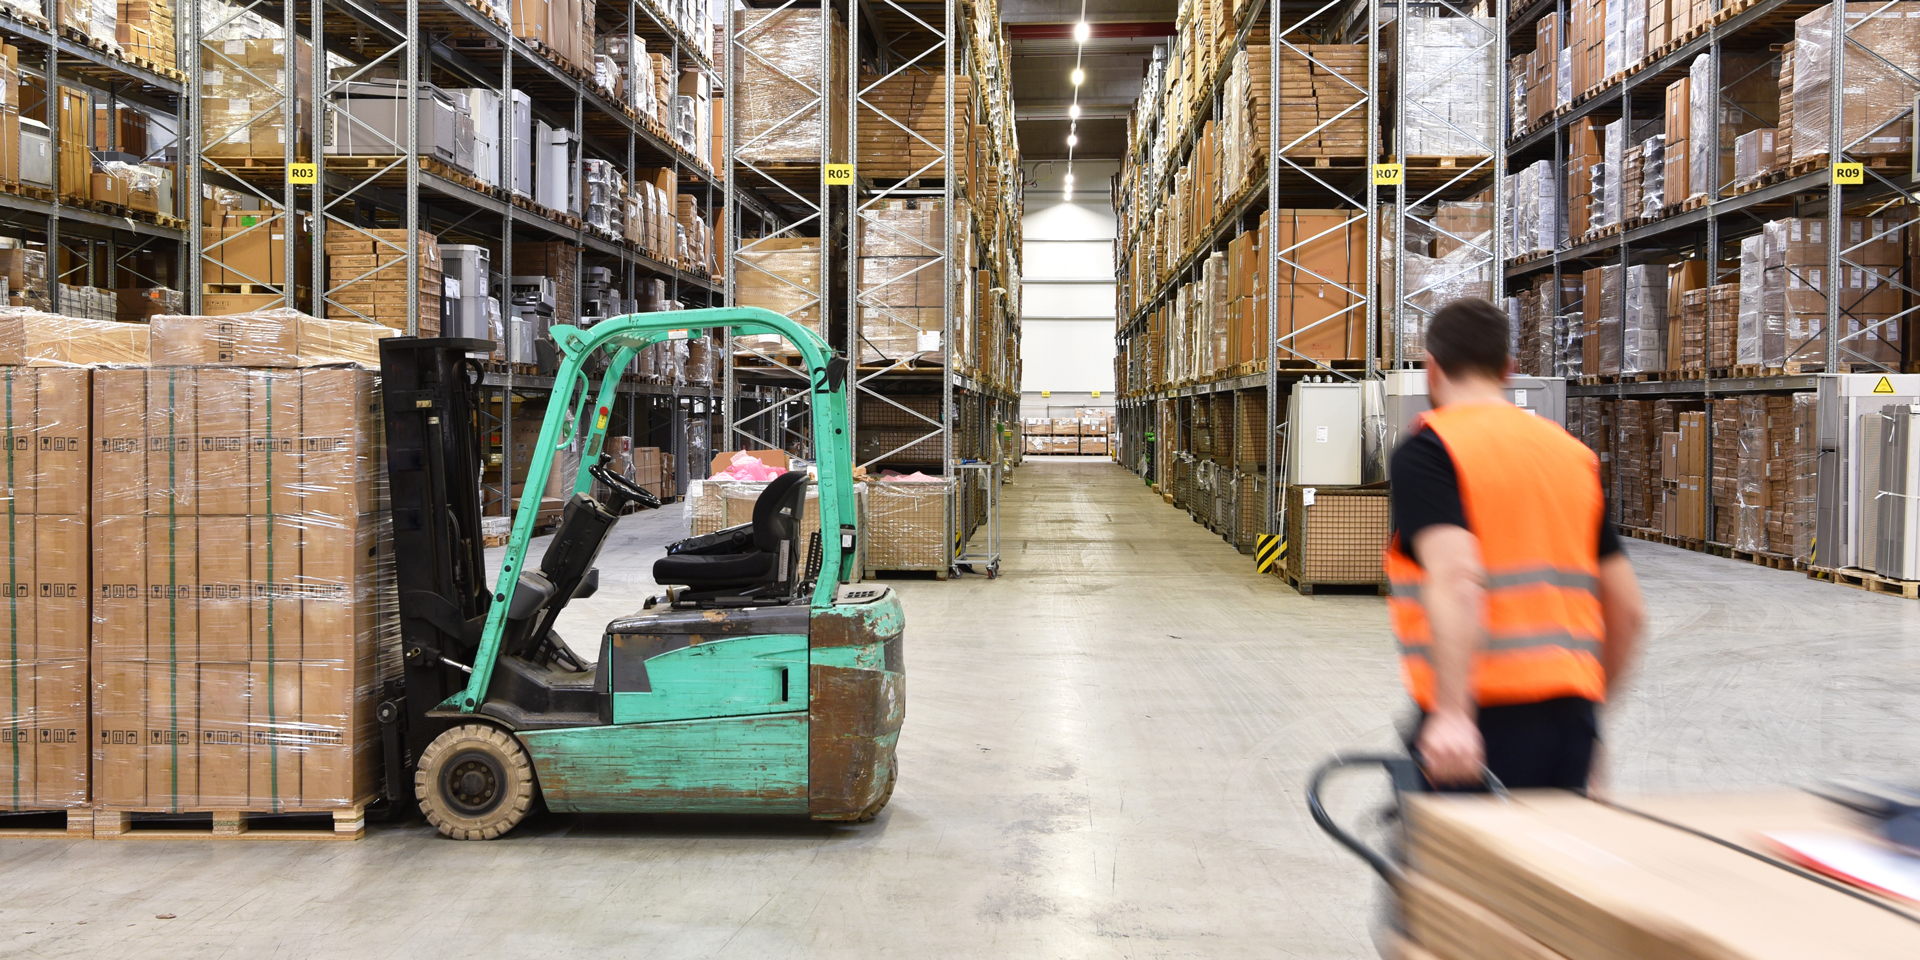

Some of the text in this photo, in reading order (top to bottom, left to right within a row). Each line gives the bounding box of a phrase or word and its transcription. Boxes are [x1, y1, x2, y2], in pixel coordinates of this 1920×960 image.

[292, 169, 314, 178] R03
[828, 169, 850, 178] R05
[1376, 169, 1399, 178] R07
[1837, 169, 1860, 178] R09
[814, 367, 829, 394] 2
